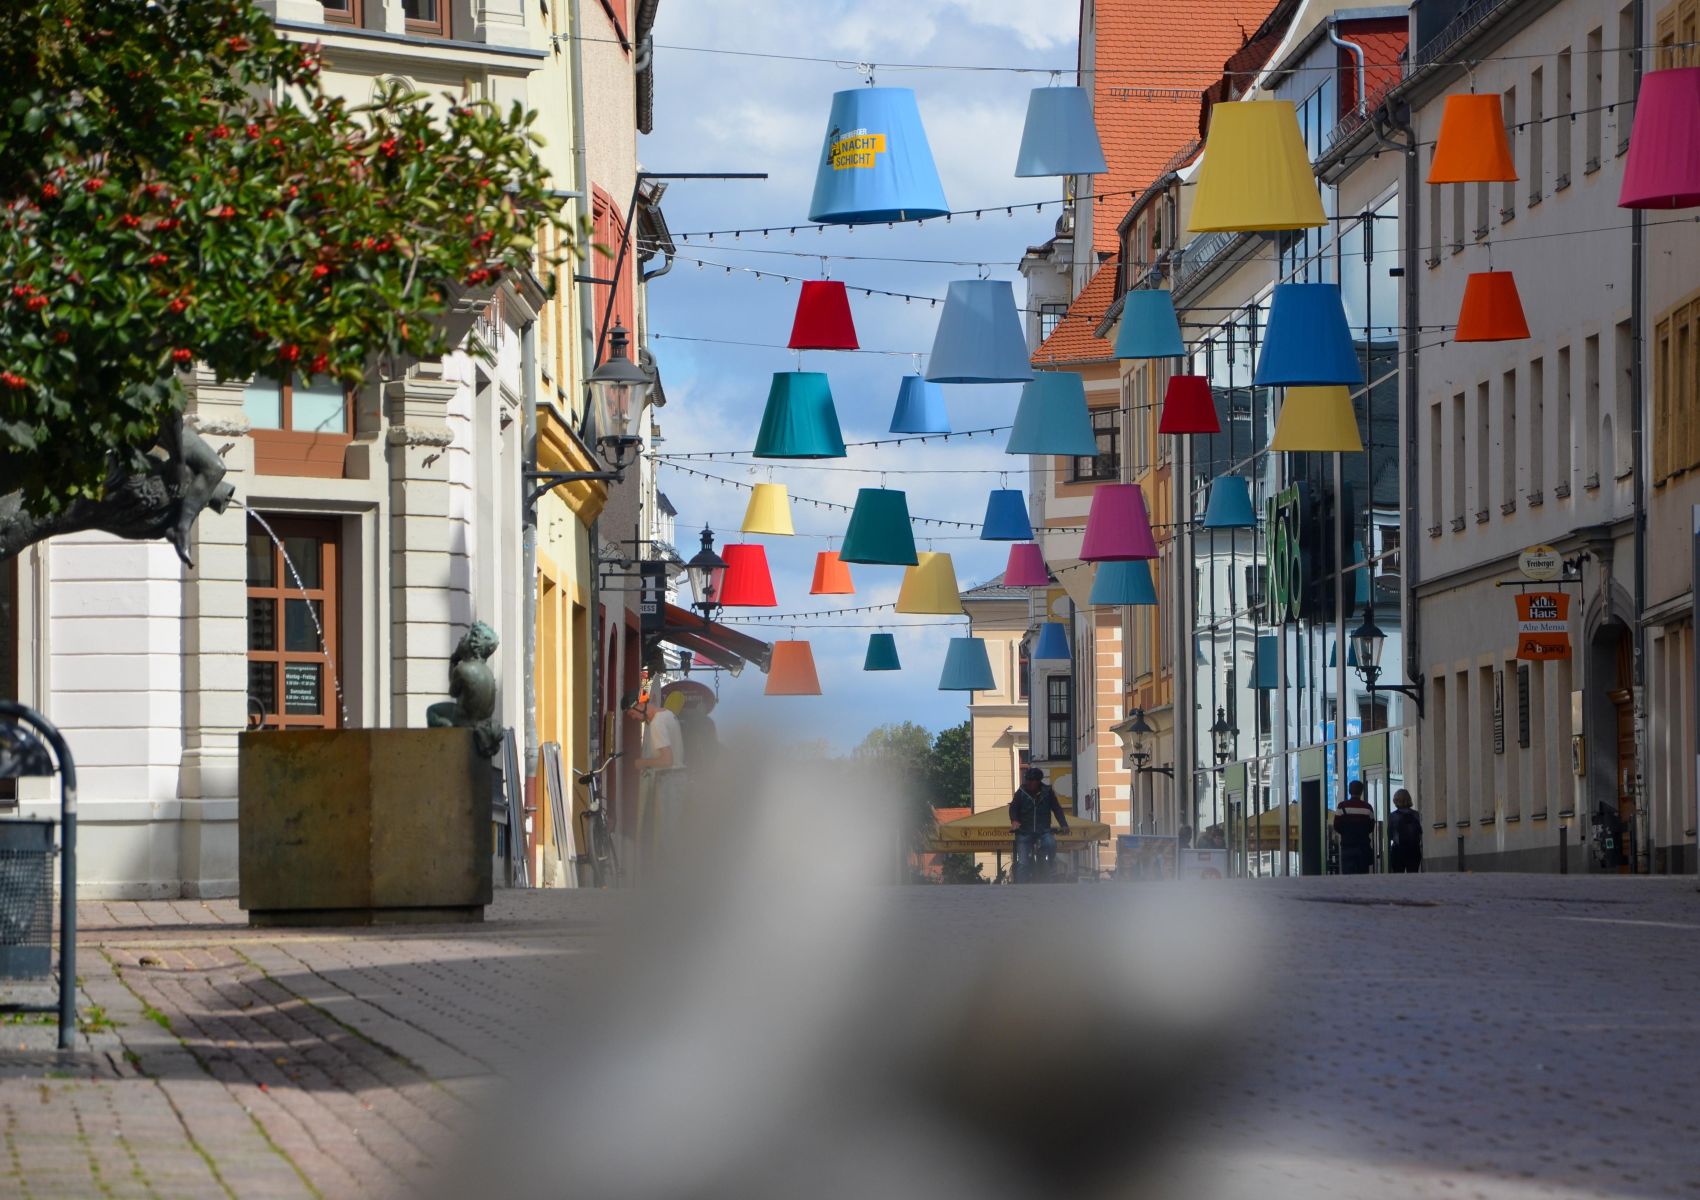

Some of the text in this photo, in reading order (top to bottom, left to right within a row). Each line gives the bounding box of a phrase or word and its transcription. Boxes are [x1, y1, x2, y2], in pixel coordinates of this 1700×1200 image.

[841, 137, 877, 153] NACHT
[835, 152, 872, 167] SCHICHT
[1526, 560, 1555, 569] Freiberger
[1529, 595, 1557, 607] Klub
[1529, 608, 1557, 618] Haus
[1522, 623, 1565, 631] Alte Mensa
